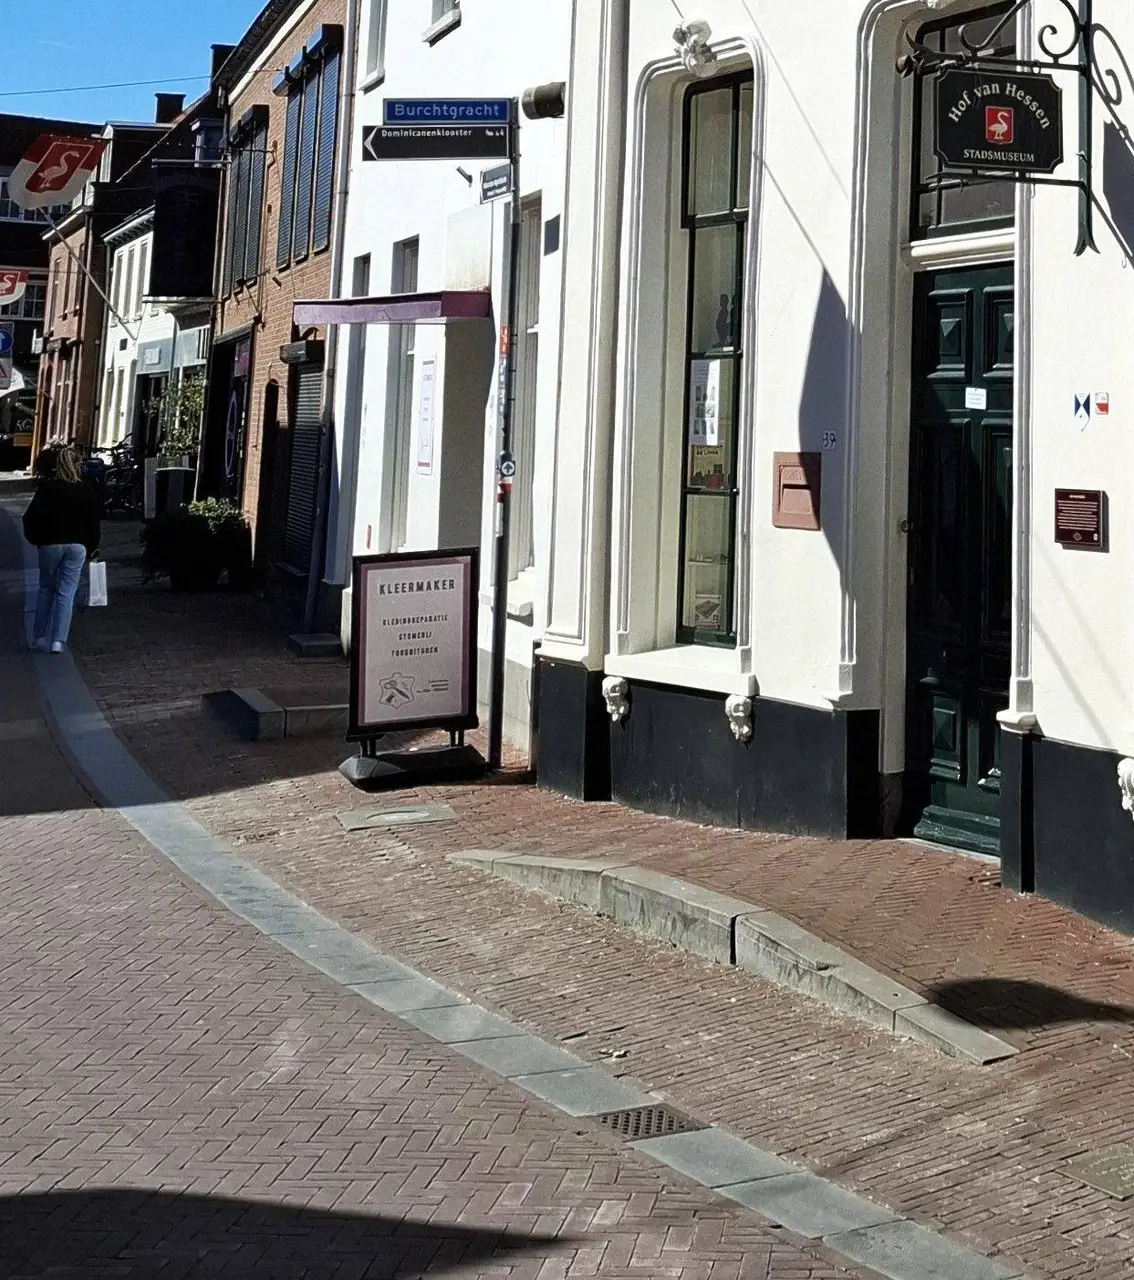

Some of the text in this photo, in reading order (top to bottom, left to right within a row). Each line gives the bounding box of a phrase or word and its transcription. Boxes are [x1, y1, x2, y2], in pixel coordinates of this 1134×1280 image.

[394, 103, 500, 119] Burchtgracht
[947, 82, 1051, 129] Hof van Hessen
[381, 128, 472, 138] Dominicanenklooster
[963, 148, 1035, 162] STADSMUSEUM
[379, 579, 455, 596] KLEERMAKER
